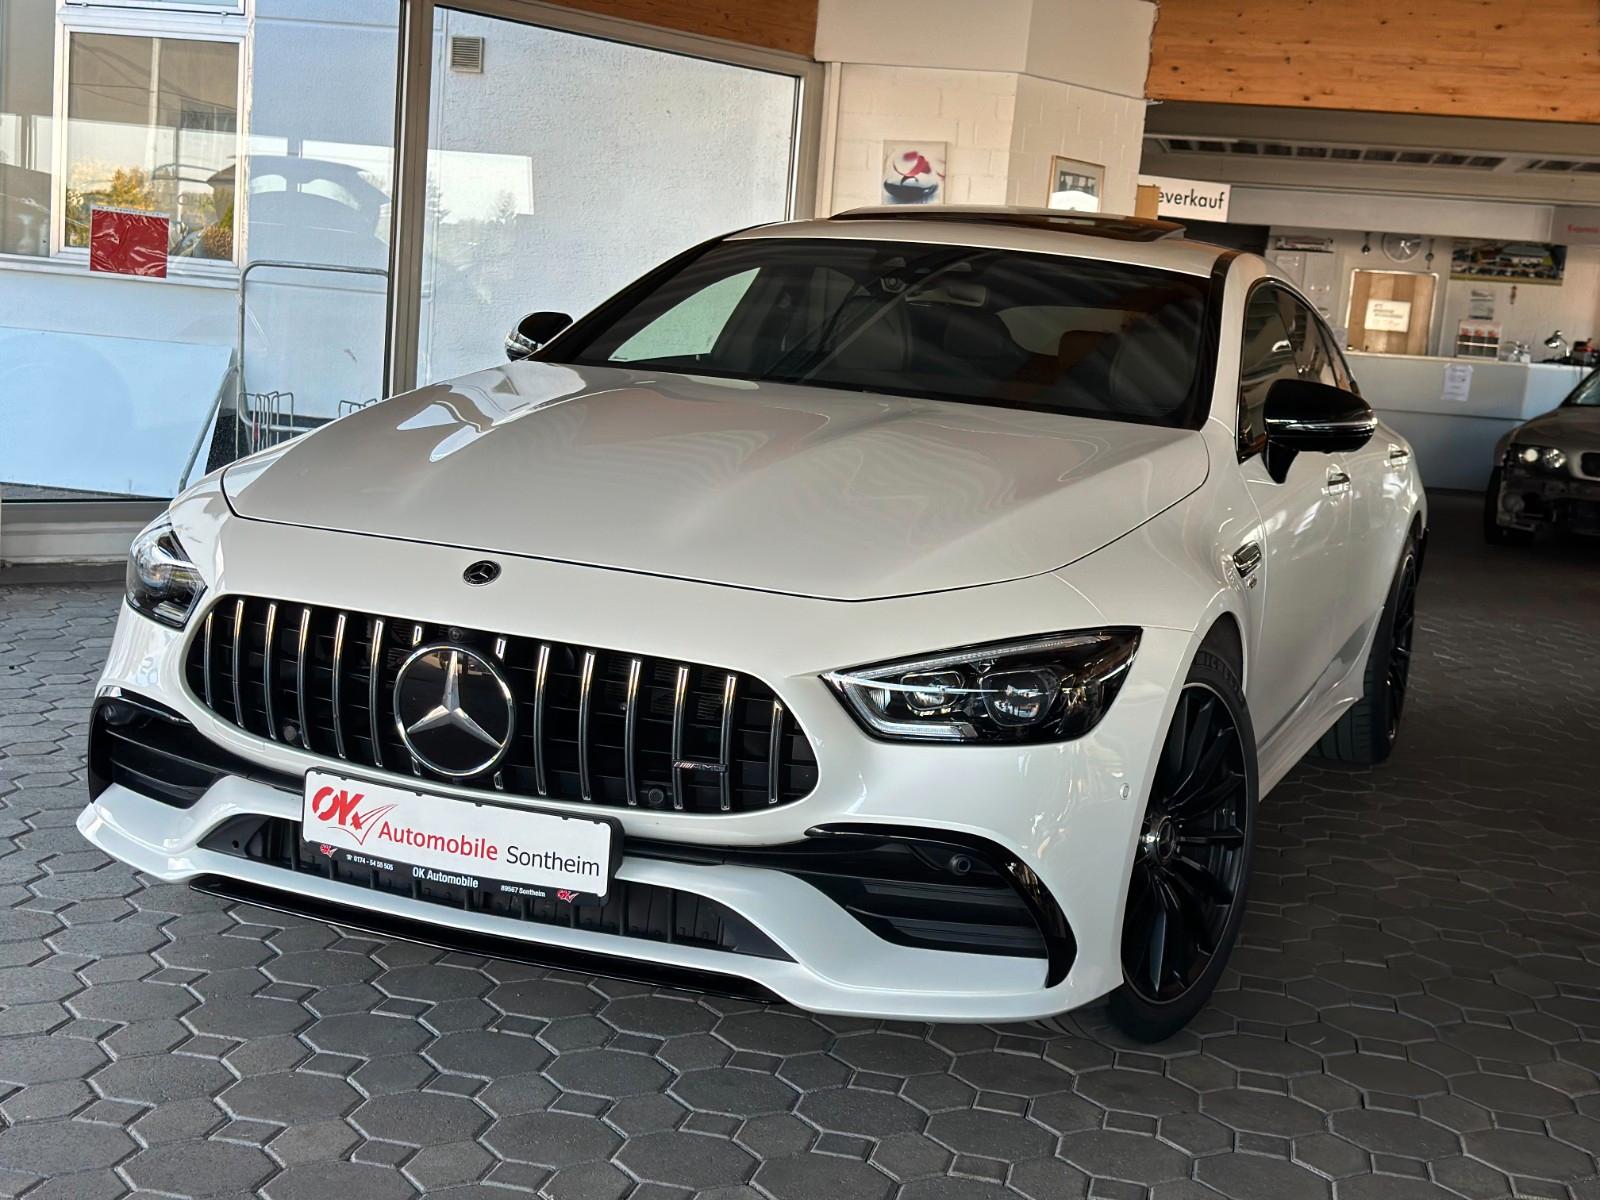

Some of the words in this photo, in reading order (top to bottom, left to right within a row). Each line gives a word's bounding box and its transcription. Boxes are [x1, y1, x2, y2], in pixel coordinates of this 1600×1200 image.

[378, 821, 498, 861] Automobile
[506, 845, 600, 877] Sontheim
[353, 855, 366, 864] 0174
[412, 866, 425, 880] OK
[426, 869, 479, 888] Automobile
[519, 887, 546, 898] Sontheim
